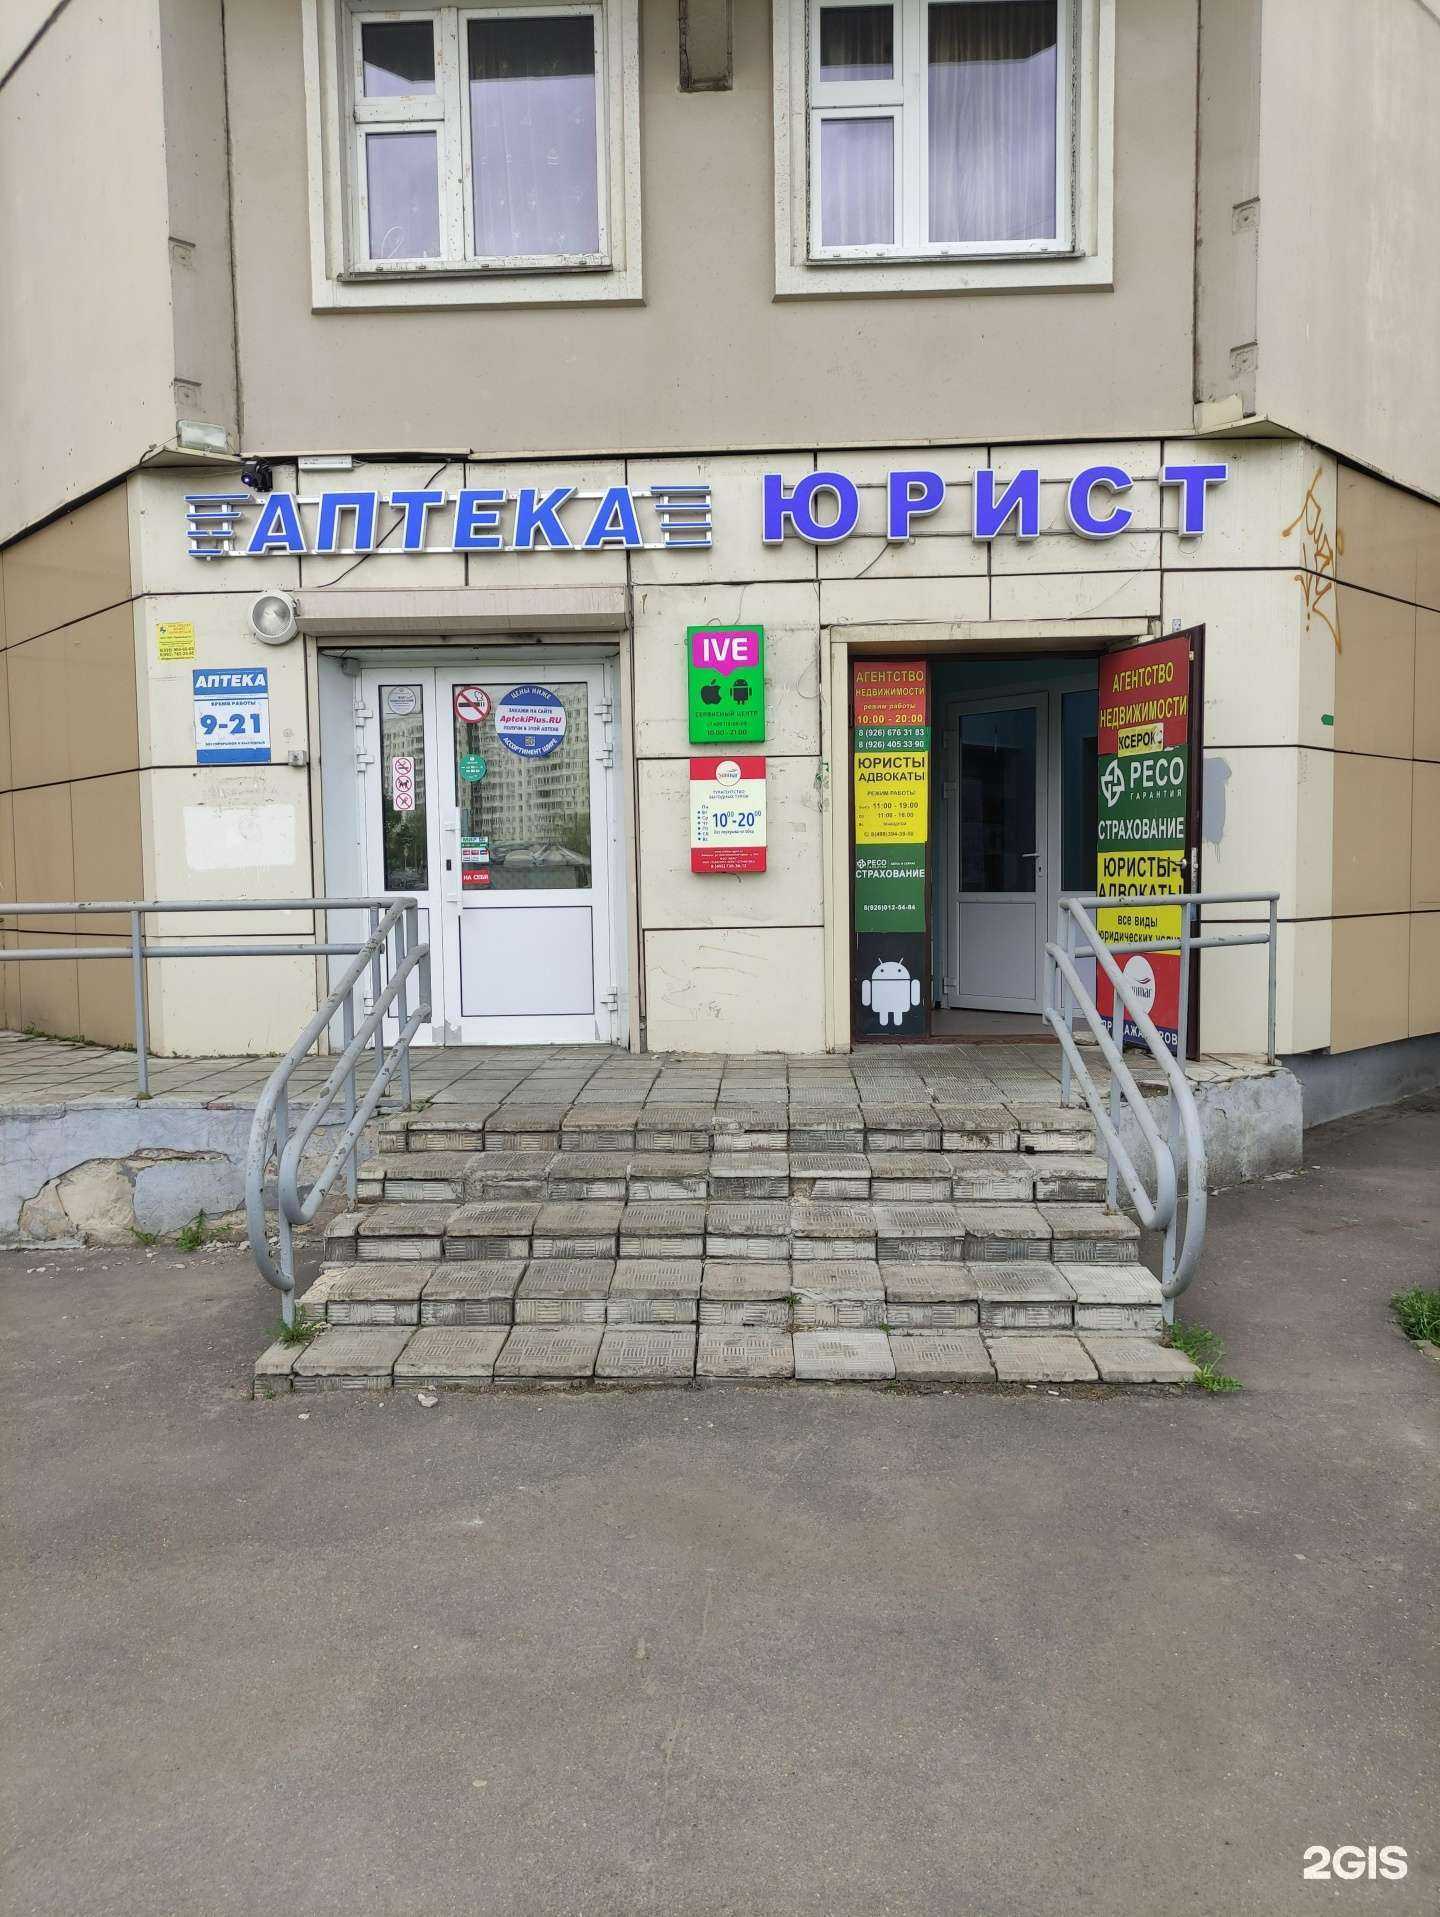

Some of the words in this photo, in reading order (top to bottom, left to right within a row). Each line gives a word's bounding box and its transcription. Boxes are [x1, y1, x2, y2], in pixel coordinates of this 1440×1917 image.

[762, 463, 1228, 546] ЮРИСТ
[246, 486, 645, 554] АПТЕКА
[703, 637, 748, 662] IVE
[195, 673, 266, 688] АПТЕКА
[856, 670, 924, 683] АГЕНТСТВО
[1112, 662, 1174, 694] АГЕНТСТВО
[855, 687, 925, 697] НЕДВИЖИМОСТИ
[1100, 695, 1187, 729] НЕДВИЖИМОСТИ
[200, 713, 261, 735] 9-21
[499, 715, 562, 724] AptekiPlus.RU
[857, 715, 884, 724] 10:00
[895, 714, 923, 723] 20:00
[865, 729, 885, 738] (926)
[914, 740, 924, 748] 90
[858, 757, 925, 769] ЮРИСТЫ
[858, 772, 925, 783] АДВОКАТЫ
[1130, 757, 1184, 789] РЕСО
[1130, 788, 1182, 801] ГАРАНТИЯ
[1098, 817, 1184, 840] СТРАХОВАНИЕ
[855, 869, 925, 878] СТРАХОВАНИЕ
[1117, 915, 1132, 926] все
[1134, 915, 1158, 929] виды
